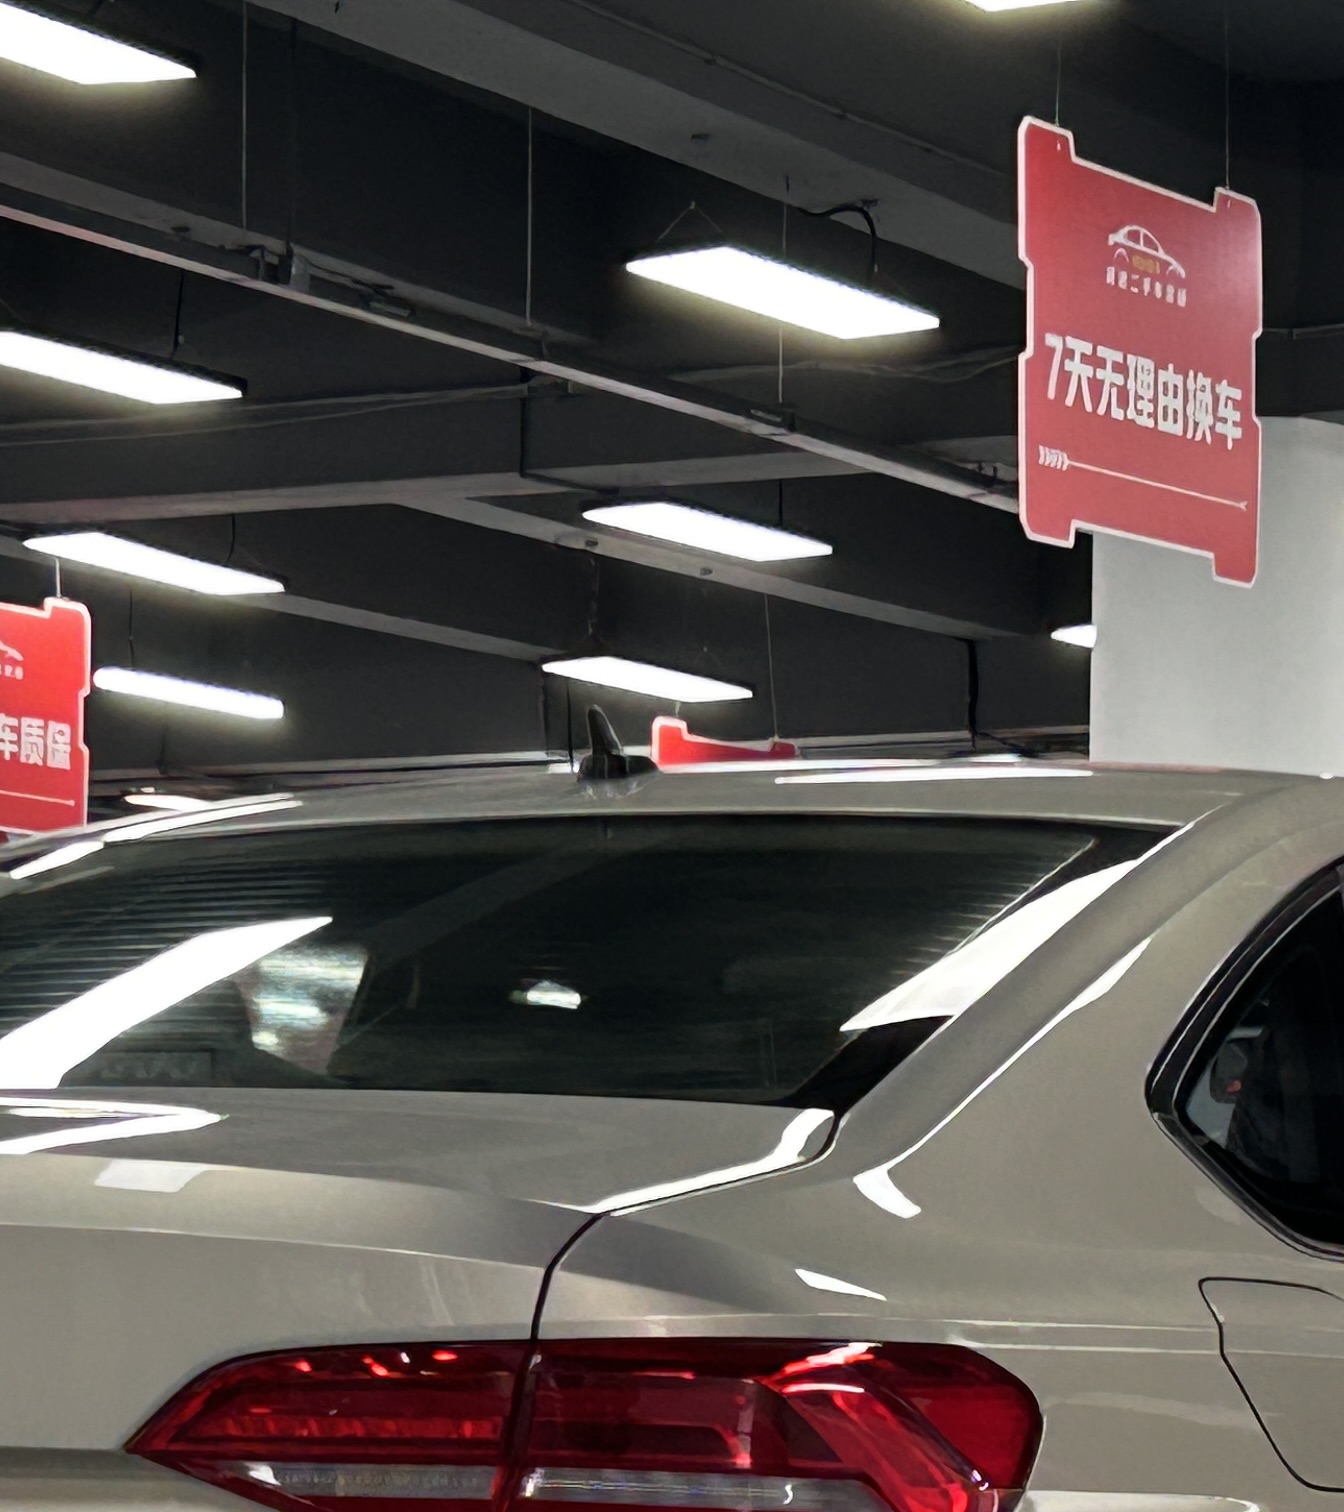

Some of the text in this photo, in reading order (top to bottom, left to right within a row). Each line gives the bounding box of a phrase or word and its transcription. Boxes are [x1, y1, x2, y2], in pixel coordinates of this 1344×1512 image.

[1044, 332, 1243, 450] 7天无理由换车
